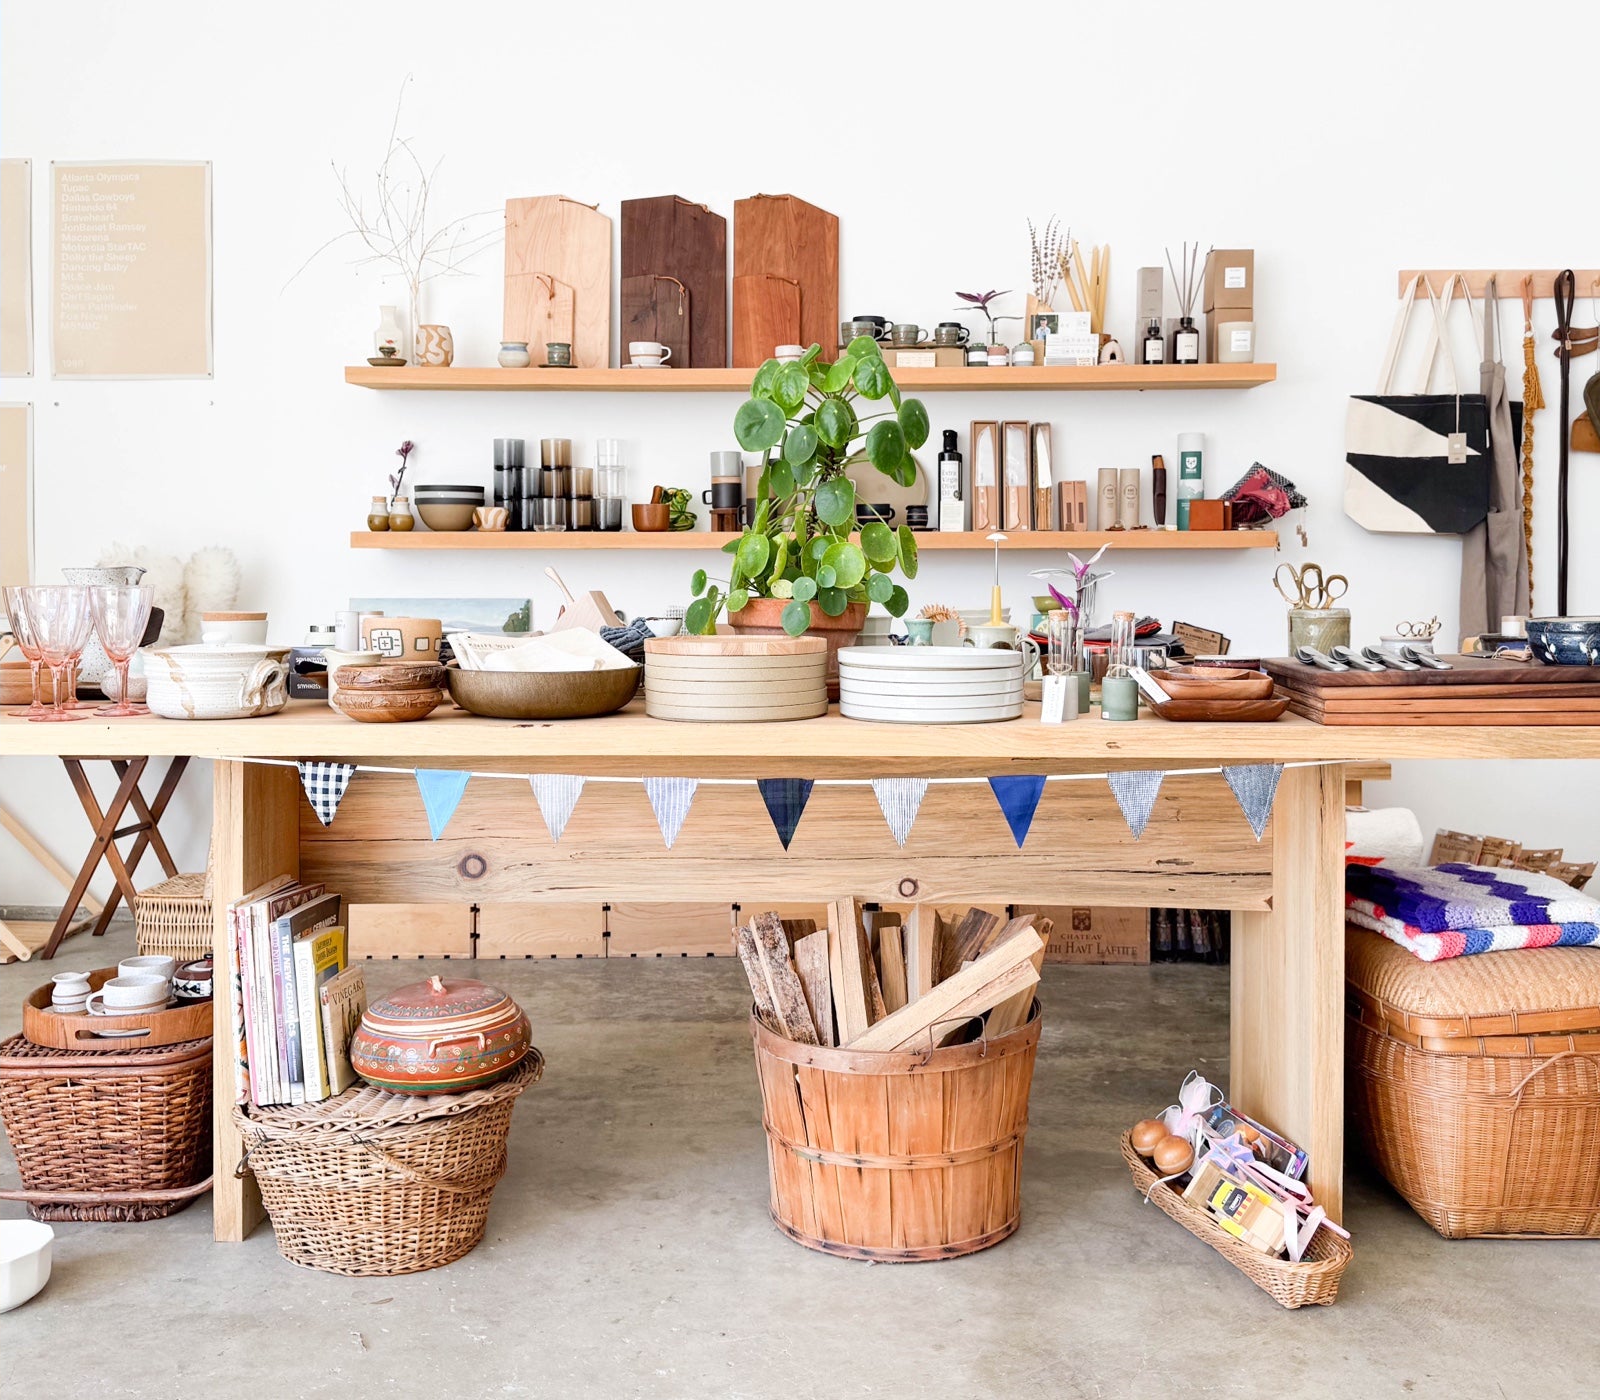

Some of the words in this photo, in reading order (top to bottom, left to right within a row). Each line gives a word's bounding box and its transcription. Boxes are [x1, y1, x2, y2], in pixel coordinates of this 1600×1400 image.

[92, 193, 135, 203] Cowboys
[313, 914, 337, 932] CERAMICS
[281, 934, 290, 955] THE
[283, 957, 293, 981] NEW
[331, 978, 365, 1005] VINEGARS
[285, 982, 297, 1037] CERAMICS
